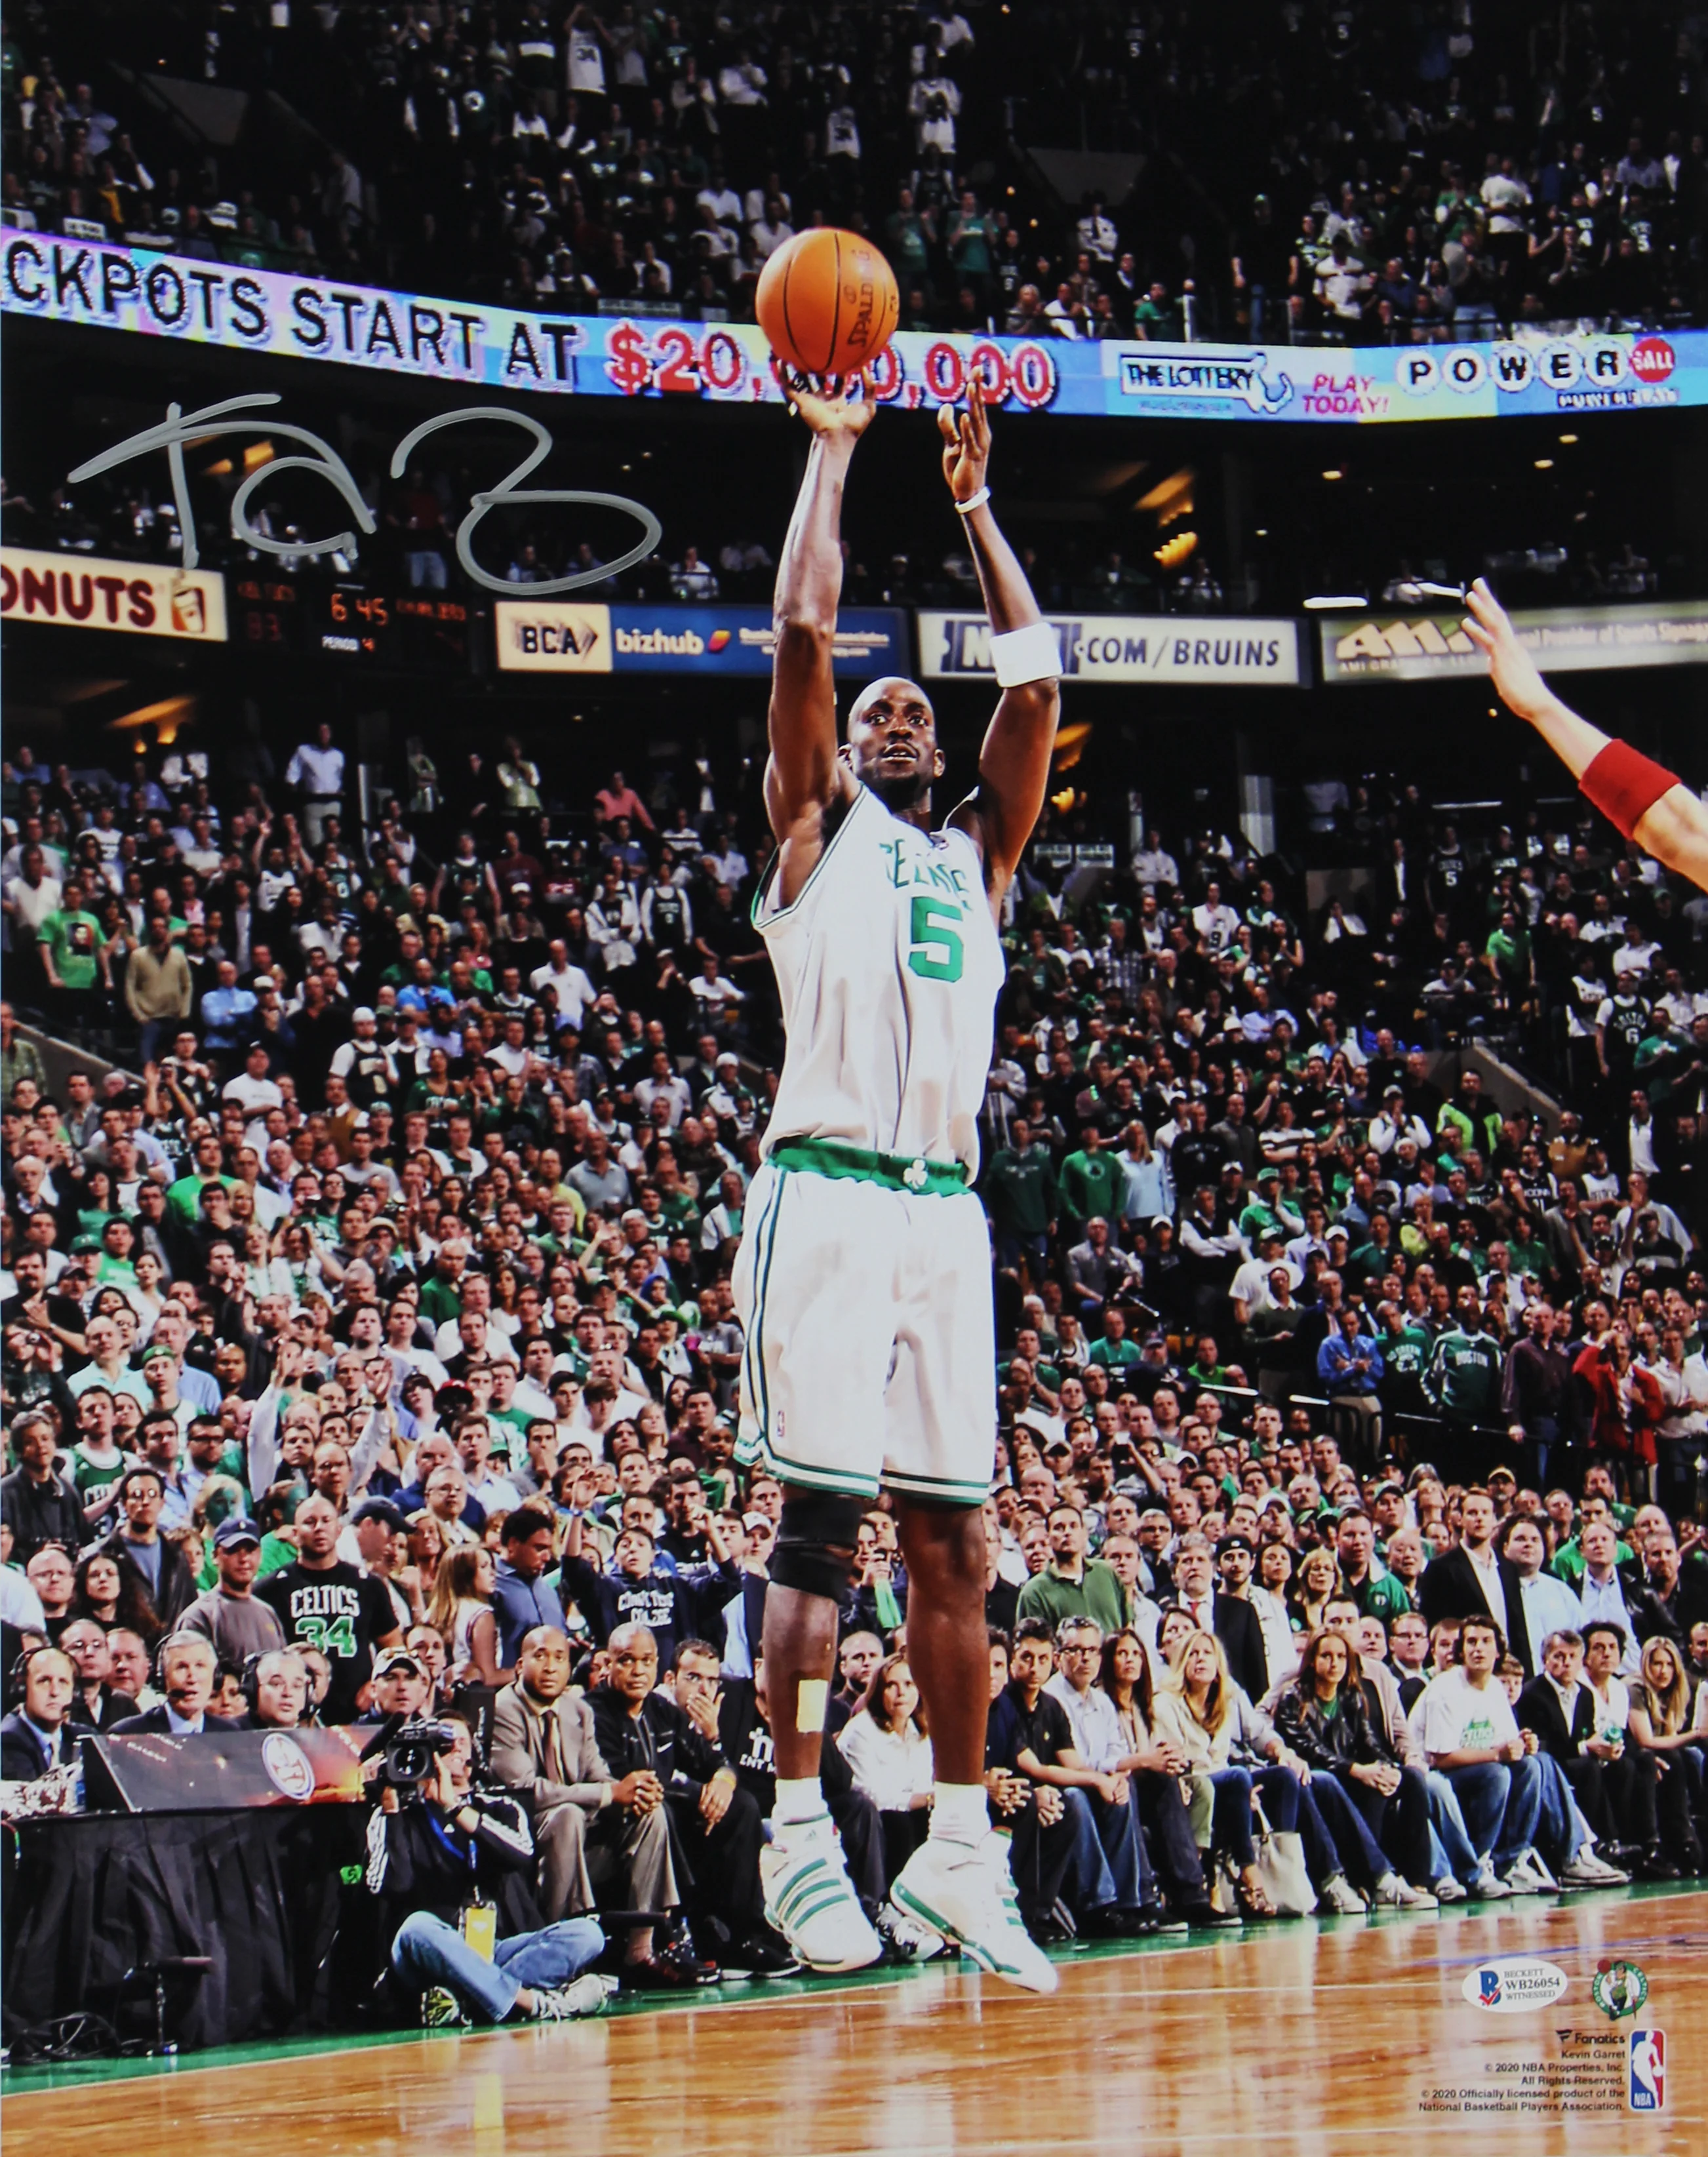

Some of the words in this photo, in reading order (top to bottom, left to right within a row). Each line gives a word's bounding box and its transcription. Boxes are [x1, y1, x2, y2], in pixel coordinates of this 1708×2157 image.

[4, 236, 269, 342] CKPOTS
[290, 286, 485, 372] START
[506, 320, 581, 386] AT
[1128, 364, 1164, 387] THE
[1169, 366, 1253, 391] LOTTERY
[1410, 349, 1619, 386] POWER
[1313, 373, 1376, 393] PLAY
[1302, 394, 1389, 414] TODAY!
[521, 625, 581, 655] BCA
[615, 627, 705, 656] bizhub
[1445, 871, 1458, 886] 5
[908, 896, 964, 983] 5
[1625, 1027, 1640, 1044] 6
[290, 1584, 361, 1618] CELTICS
[295, 1615, 358, 1657] 34
[1503, 1968, 1545, 1978] BECKETT
[1505, 1977, 1560, 1990] WB26054
[1505, 1990, 1556, 2001] WITNESSED
